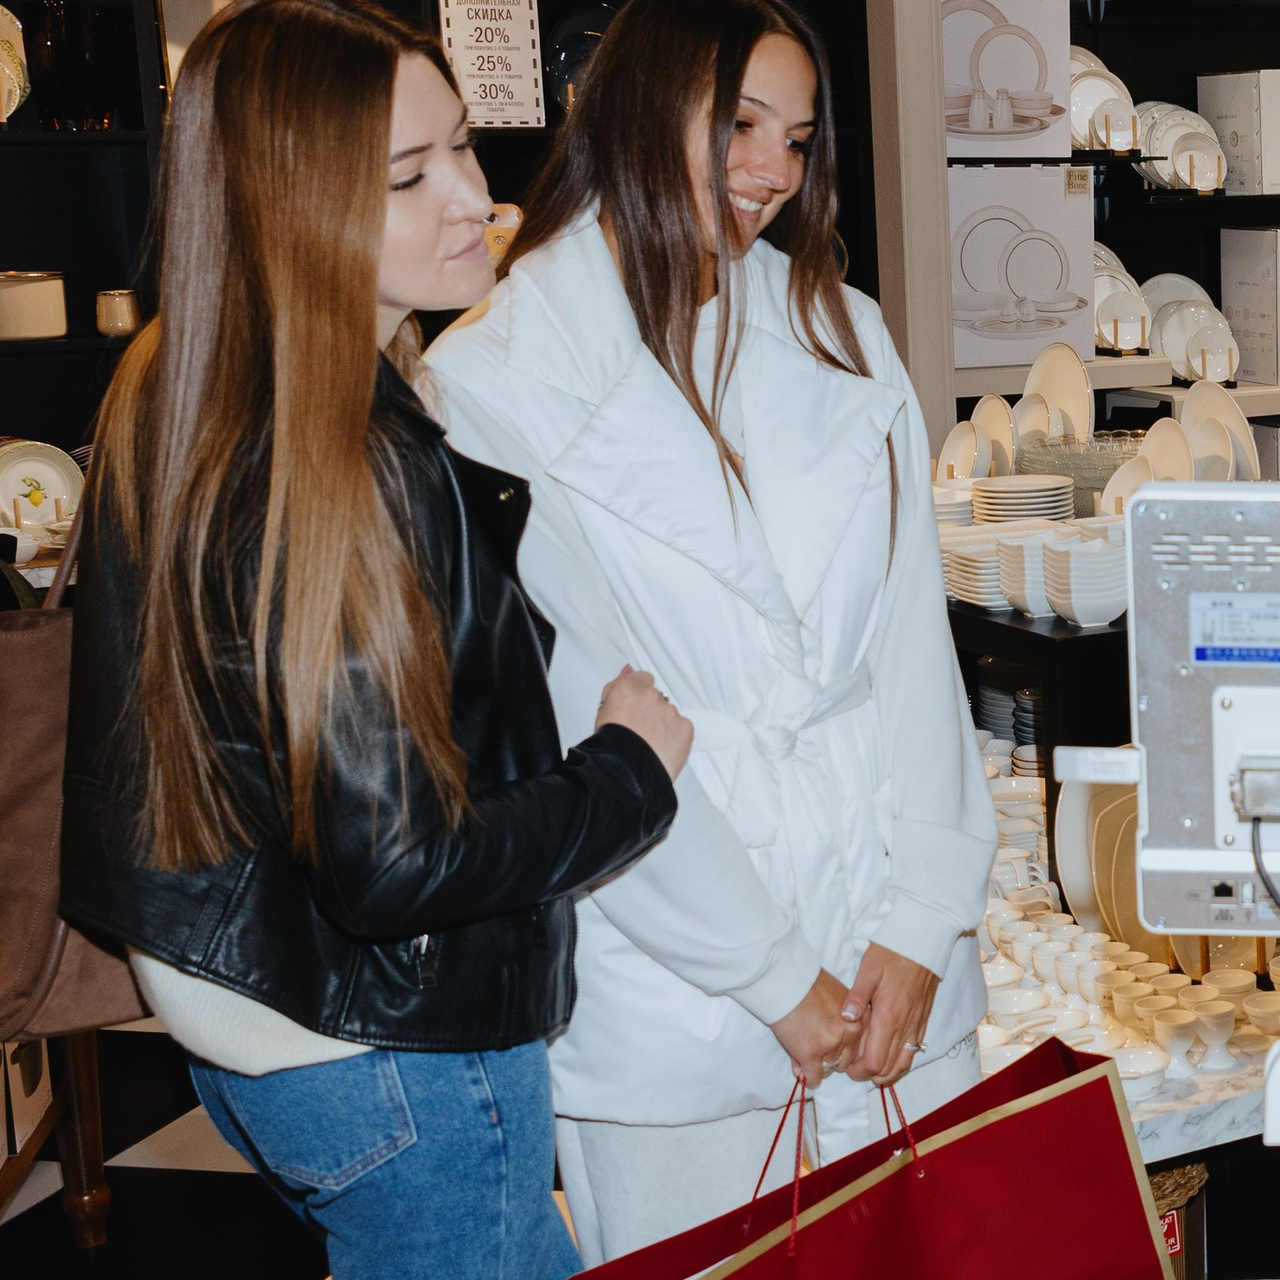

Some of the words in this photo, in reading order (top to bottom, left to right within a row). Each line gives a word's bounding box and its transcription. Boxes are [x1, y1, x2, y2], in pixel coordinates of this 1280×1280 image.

[467, 8, 513, 22] СКИДКА
[469, 27, 510, 43] -20%
[471, 55, 512, 71] -25%
[473, 83, 514, 100] -30%
[1068, 171, 1087, 181] Fine
[1068, 181, 1087, 190] Bone
